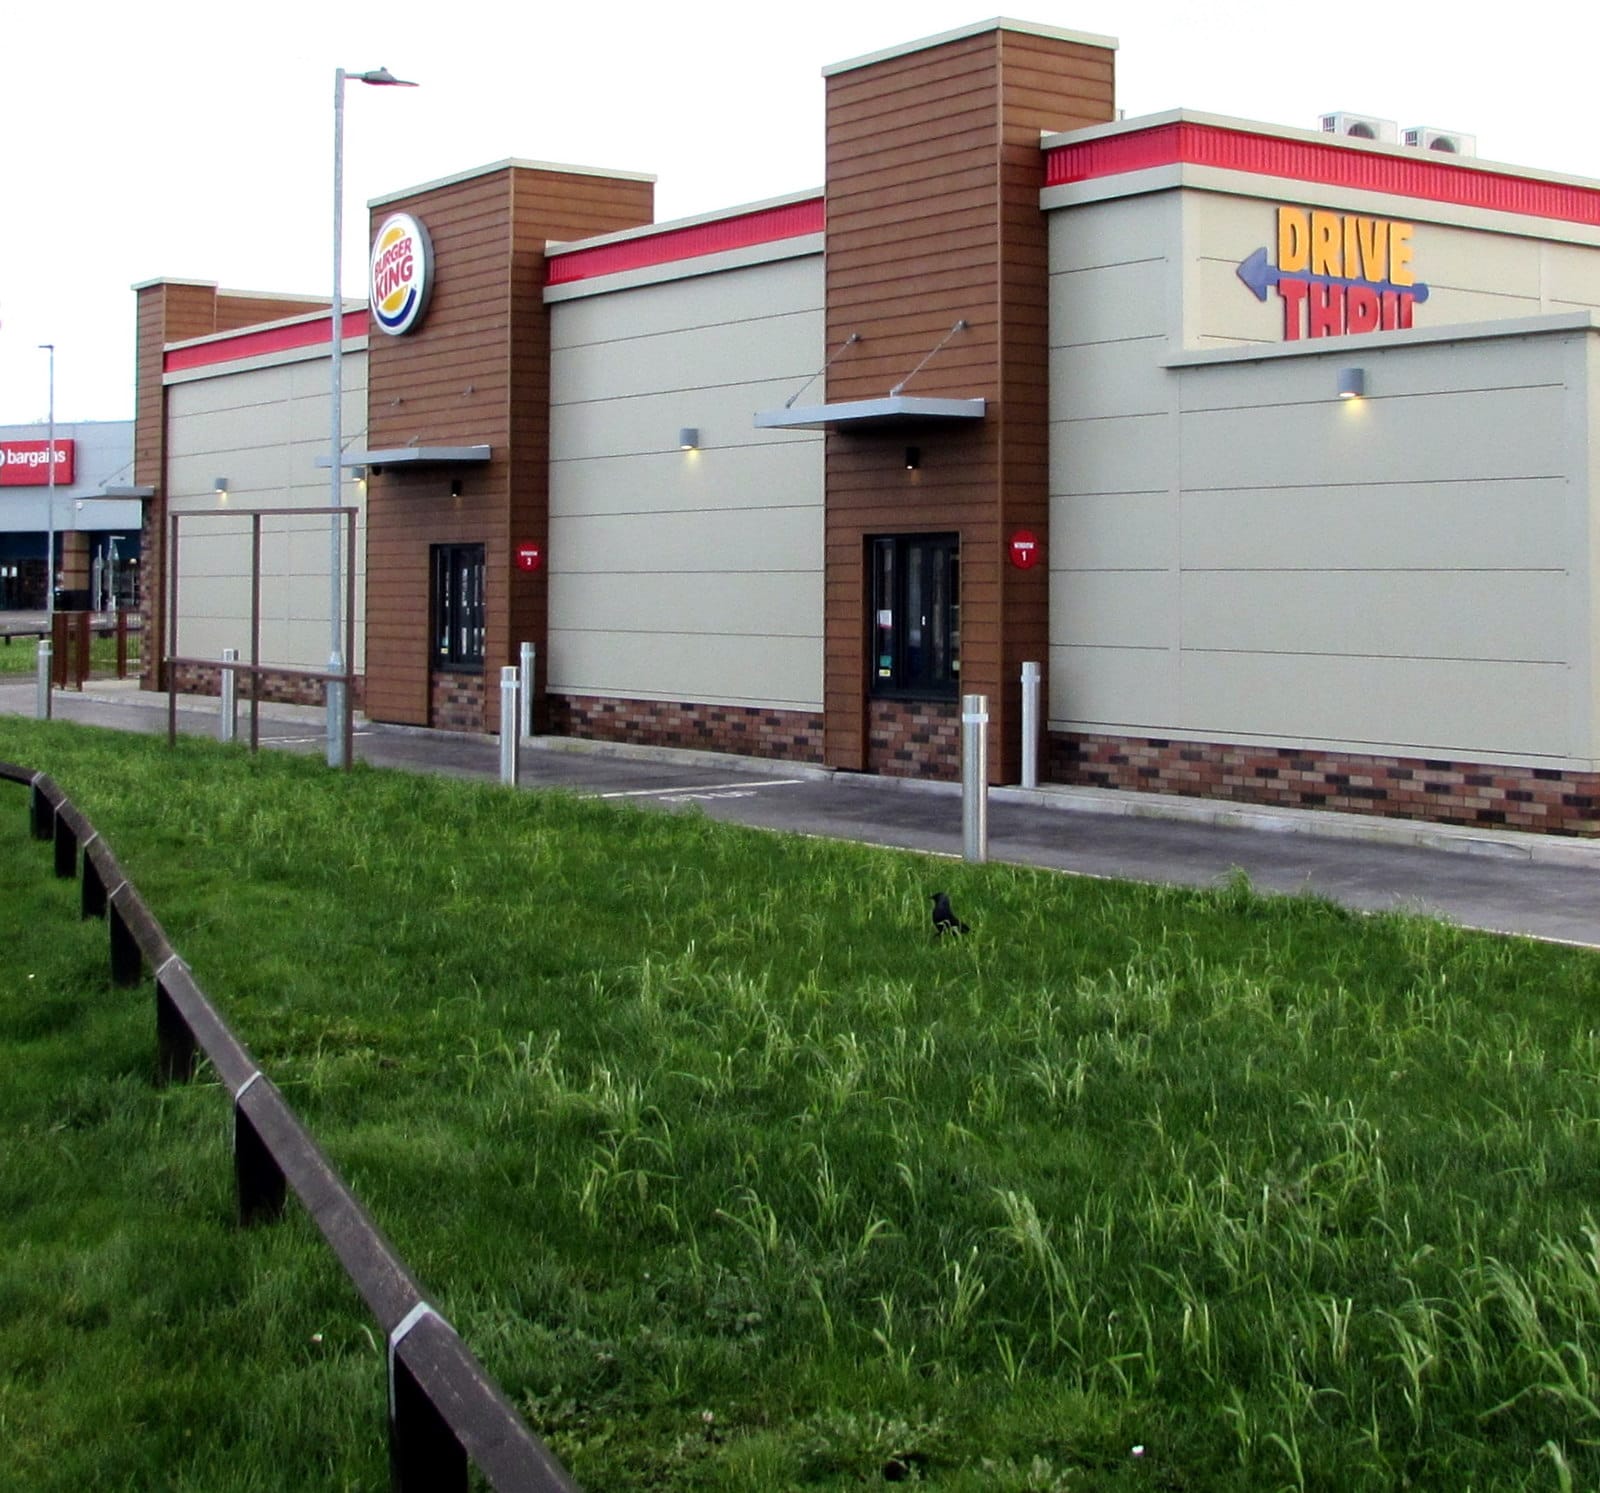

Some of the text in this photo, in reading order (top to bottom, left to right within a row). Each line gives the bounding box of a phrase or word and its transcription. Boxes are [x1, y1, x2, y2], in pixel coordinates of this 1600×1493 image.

[375, 237, 412, 276] BURGER
[1277, 206, 1414, 286] DRIVE
[376, 255, 413, 309] KING
